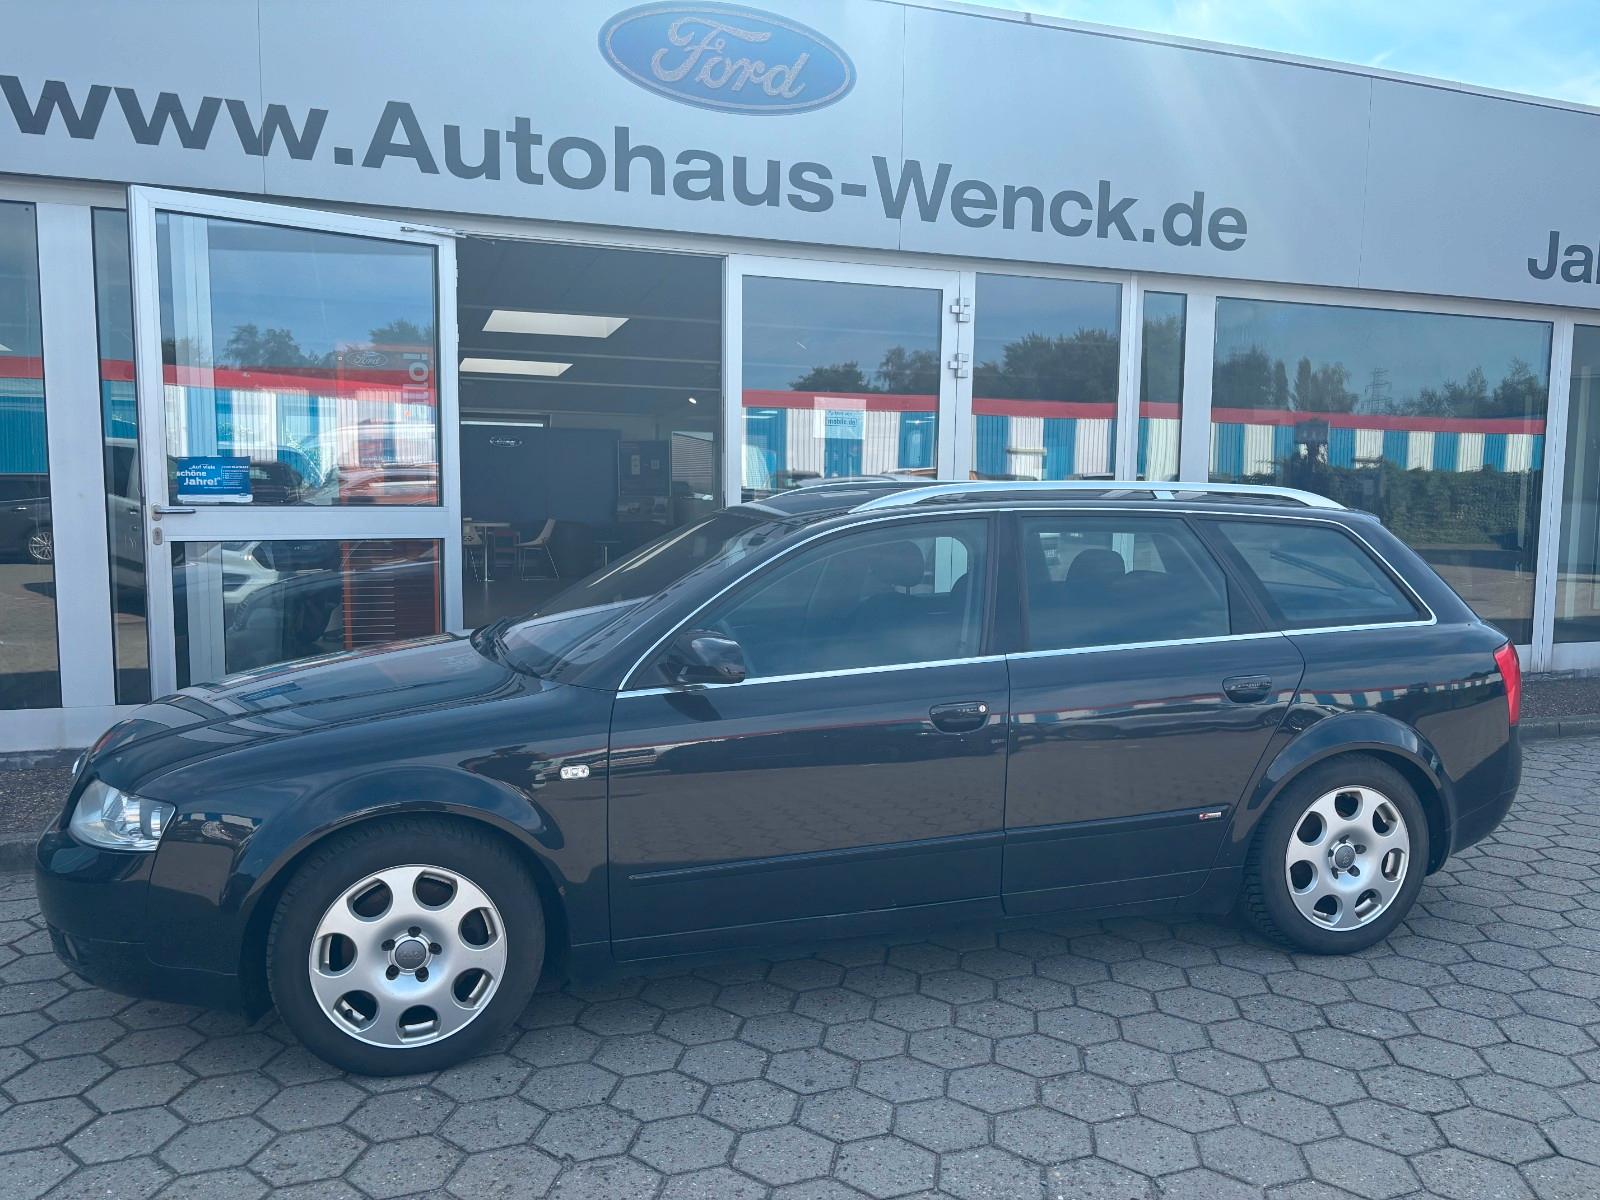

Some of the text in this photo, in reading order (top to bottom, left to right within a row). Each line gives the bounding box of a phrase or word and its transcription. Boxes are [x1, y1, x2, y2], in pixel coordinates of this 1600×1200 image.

[651, 16, 810, 99] Ford
[0, 74, 1248, 252] www.Autohaus-Wenck.de
[1527, 230, 1600, 284] Ja
[176, 469, 207, 477] schöne
